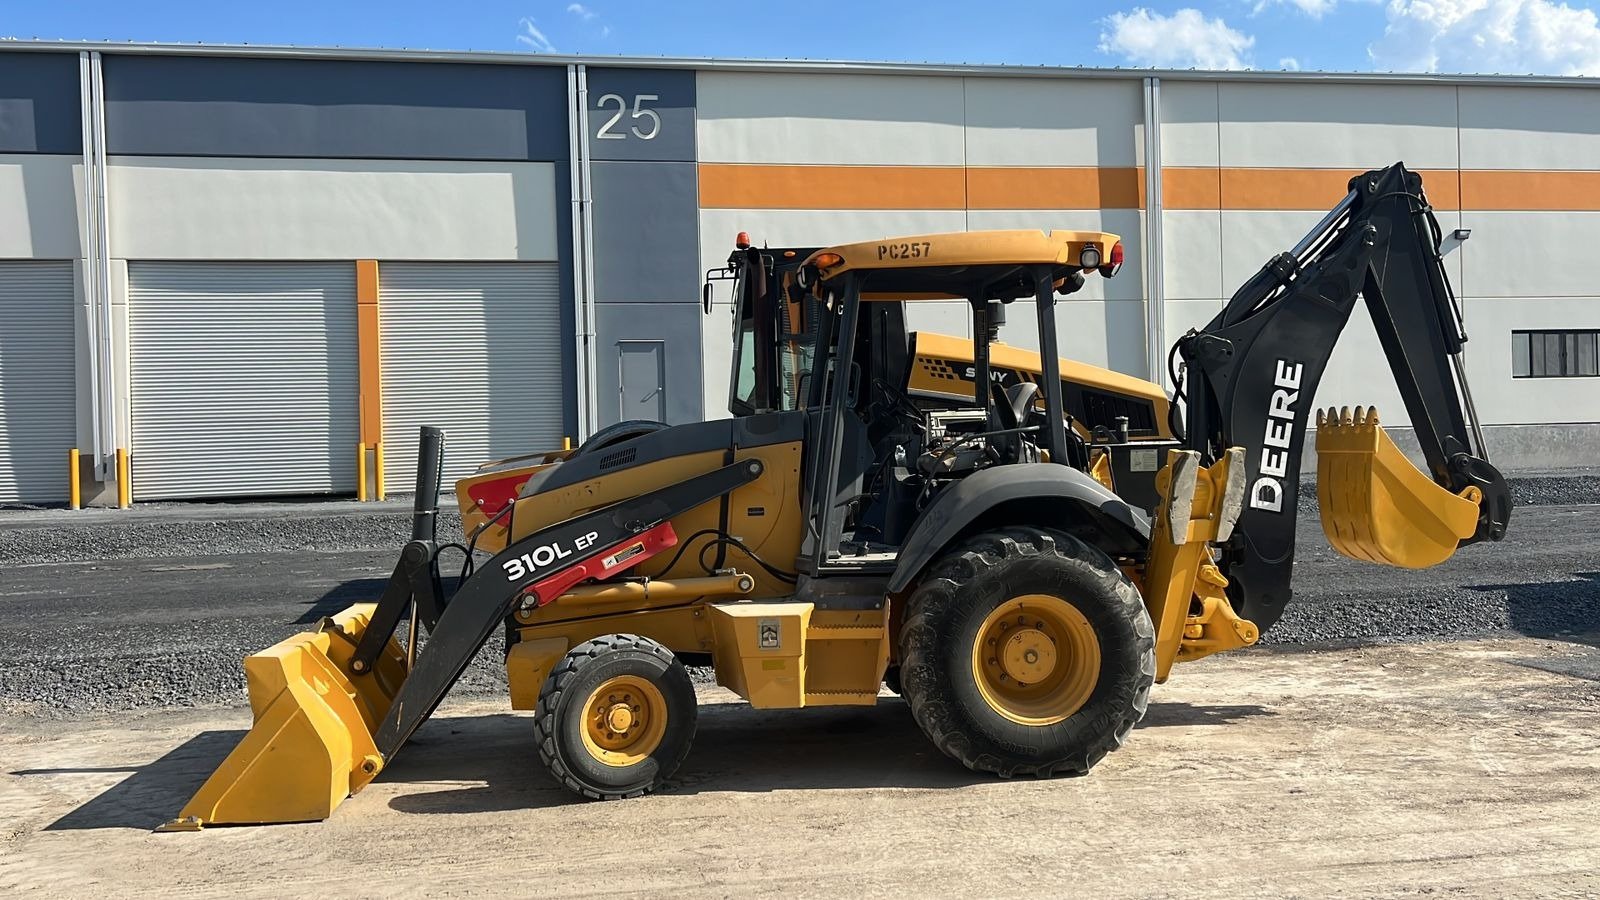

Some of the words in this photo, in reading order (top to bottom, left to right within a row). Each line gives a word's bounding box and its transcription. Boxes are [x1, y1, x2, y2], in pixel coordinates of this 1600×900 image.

[597, 94, 661, 140] 25
[878, 241, 931, 261] PC257
[965, 367, 1008, 382] SNY
[1250, 359, 1303, 513] DEERE
[502, 542, 573, 582] 310L
[574, 531, 599, 551] EP
